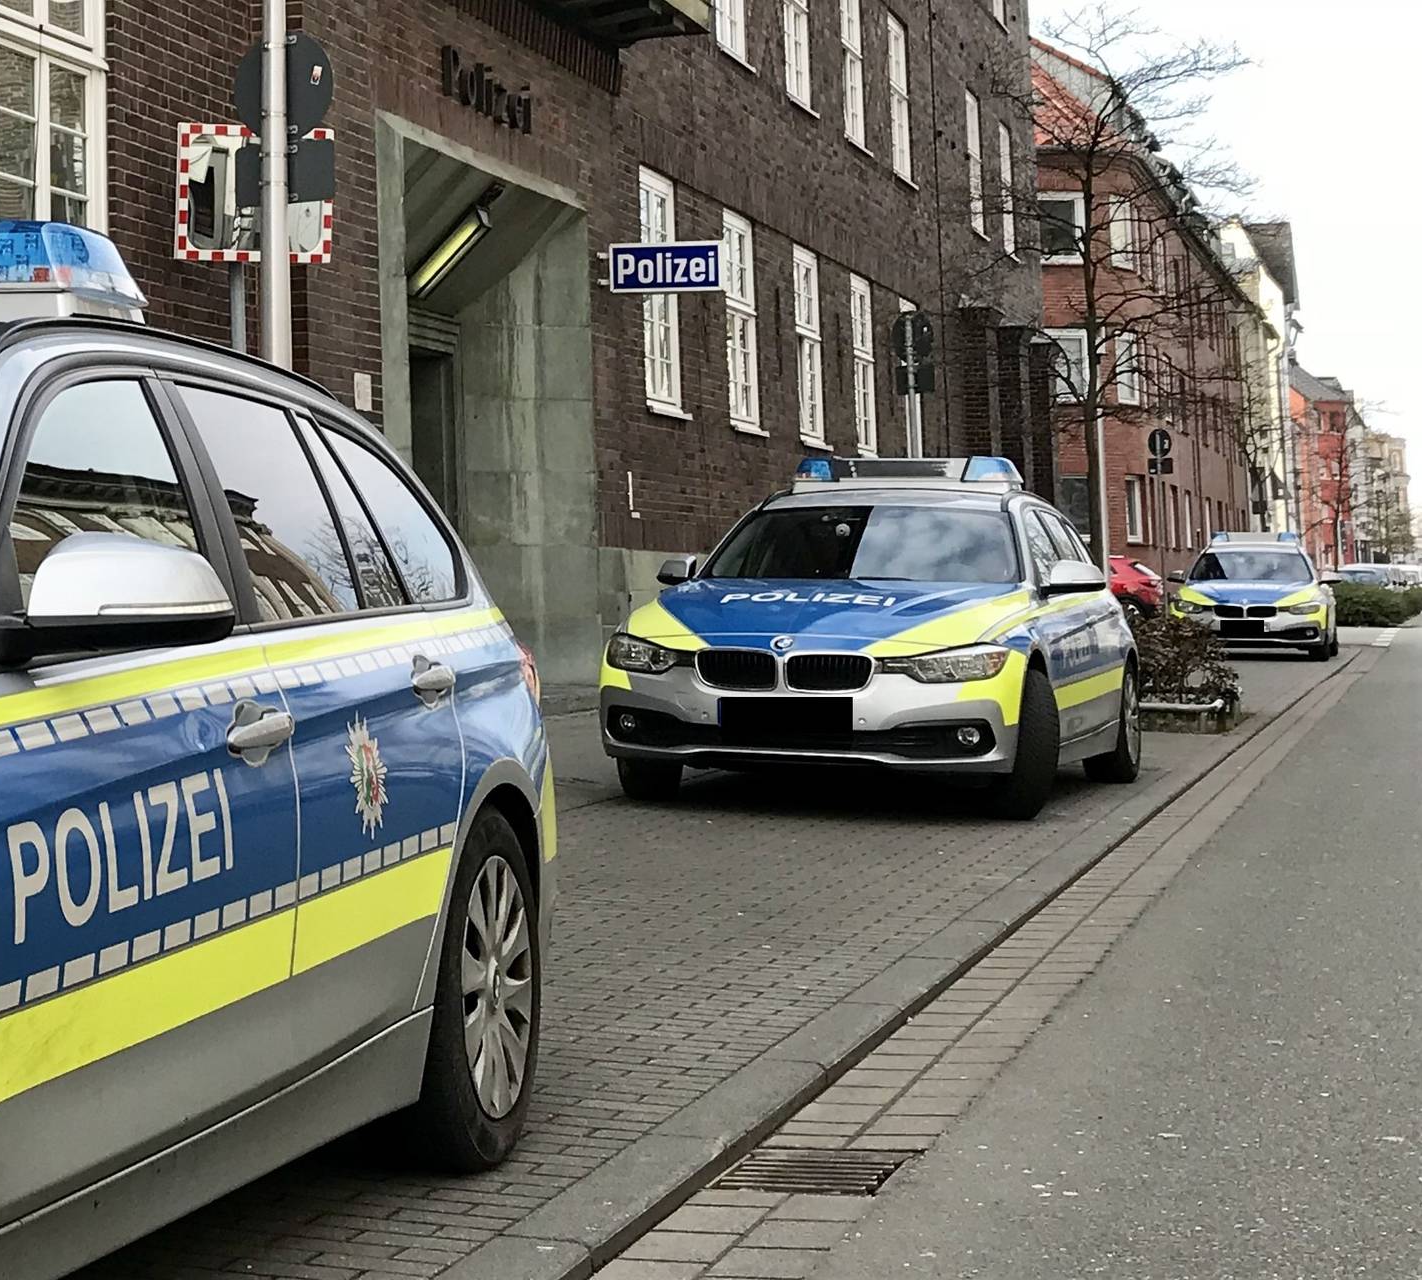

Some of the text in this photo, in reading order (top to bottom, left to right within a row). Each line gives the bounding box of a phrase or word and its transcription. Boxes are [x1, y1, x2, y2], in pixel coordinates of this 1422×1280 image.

[441, 45, 531, 135] Polizei
[617, 251, 716, 285] Polizei
[720, 592, 896, 607] POLIZEI
[7, 767, 234, 945] POLIZEI
